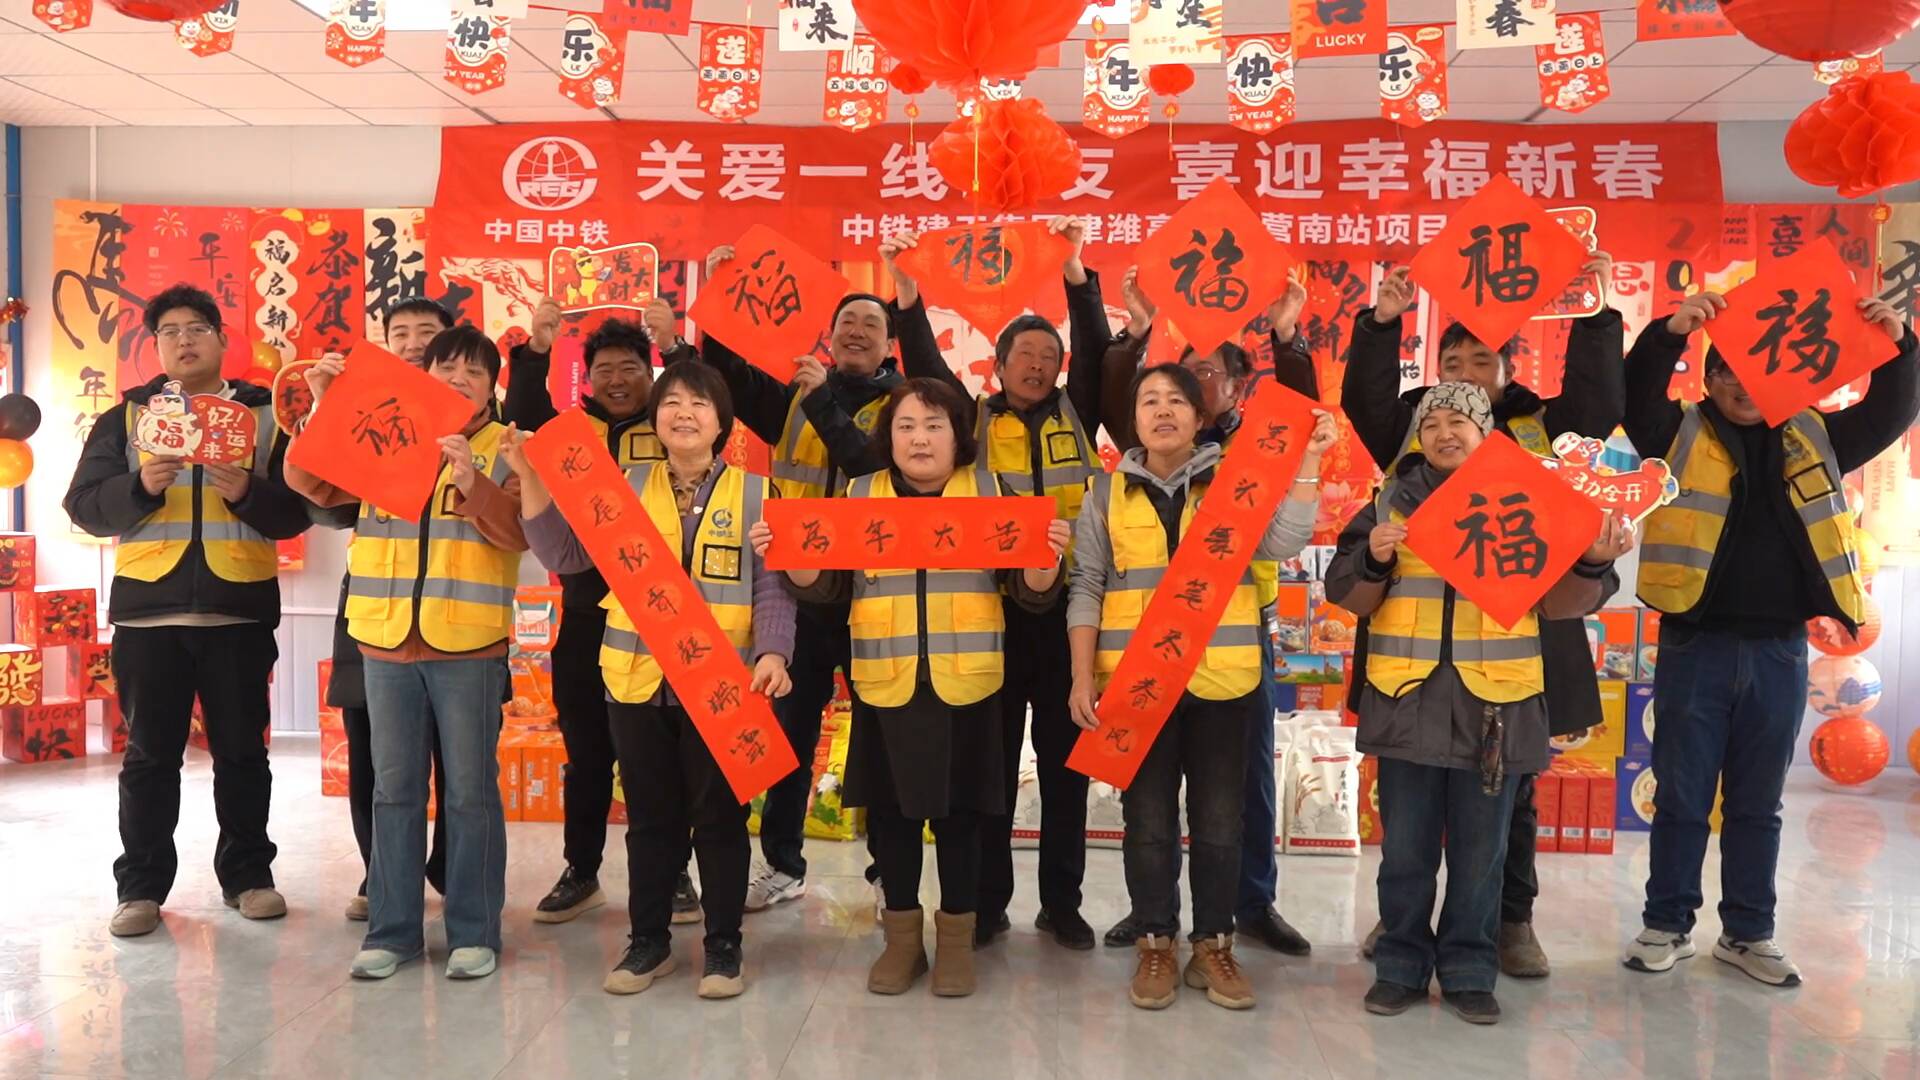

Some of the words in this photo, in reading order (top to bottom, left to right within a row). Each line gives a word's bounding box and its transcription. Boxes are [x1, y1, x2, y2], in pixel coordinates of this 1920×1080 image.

[347, 45, 376, 53] HAPPY
[455, 16, 490, 49] 快
[562, 29, 594, 62] 乐
[1315, 34, 1367, 47] LUCKY
[459, 71, 485, 80] YEAR
[841, 44, 876, 75] 顺
[1106, 57, 1139, 92] 年
[1234, 52, 1273, 87] 快
[1380, 45, 1412, 81] 乐
[829, 78, 885, 90] 五福临门
[1107, 115, 1139, 123] HAPPY
[1247, 110, 1273, 120] YEAR
[637, 140, 1114, 200] 关爱一线友
[1171, 139, 1663, 201] 喜迎幸福新春
[484, 218, 609, 245] 中国中铁
[1767, 214, 1804, 258] 喜
[188, 231, 247, 308] 平安
[609, 251, 651, 301] 发大财
[1169, 227, 1249, 313] 福
[1459, 222, 1540, 308] 福
[307, 229, 359, 353] 恭贺
[726, 249, 802, 328] 福
[1747, 288, 1842, 385] 福
[152, 422, 185, 449] 福
[1567, 471, 1642, 503] 马力全开
[1453, 491, 1549, 580] 福
